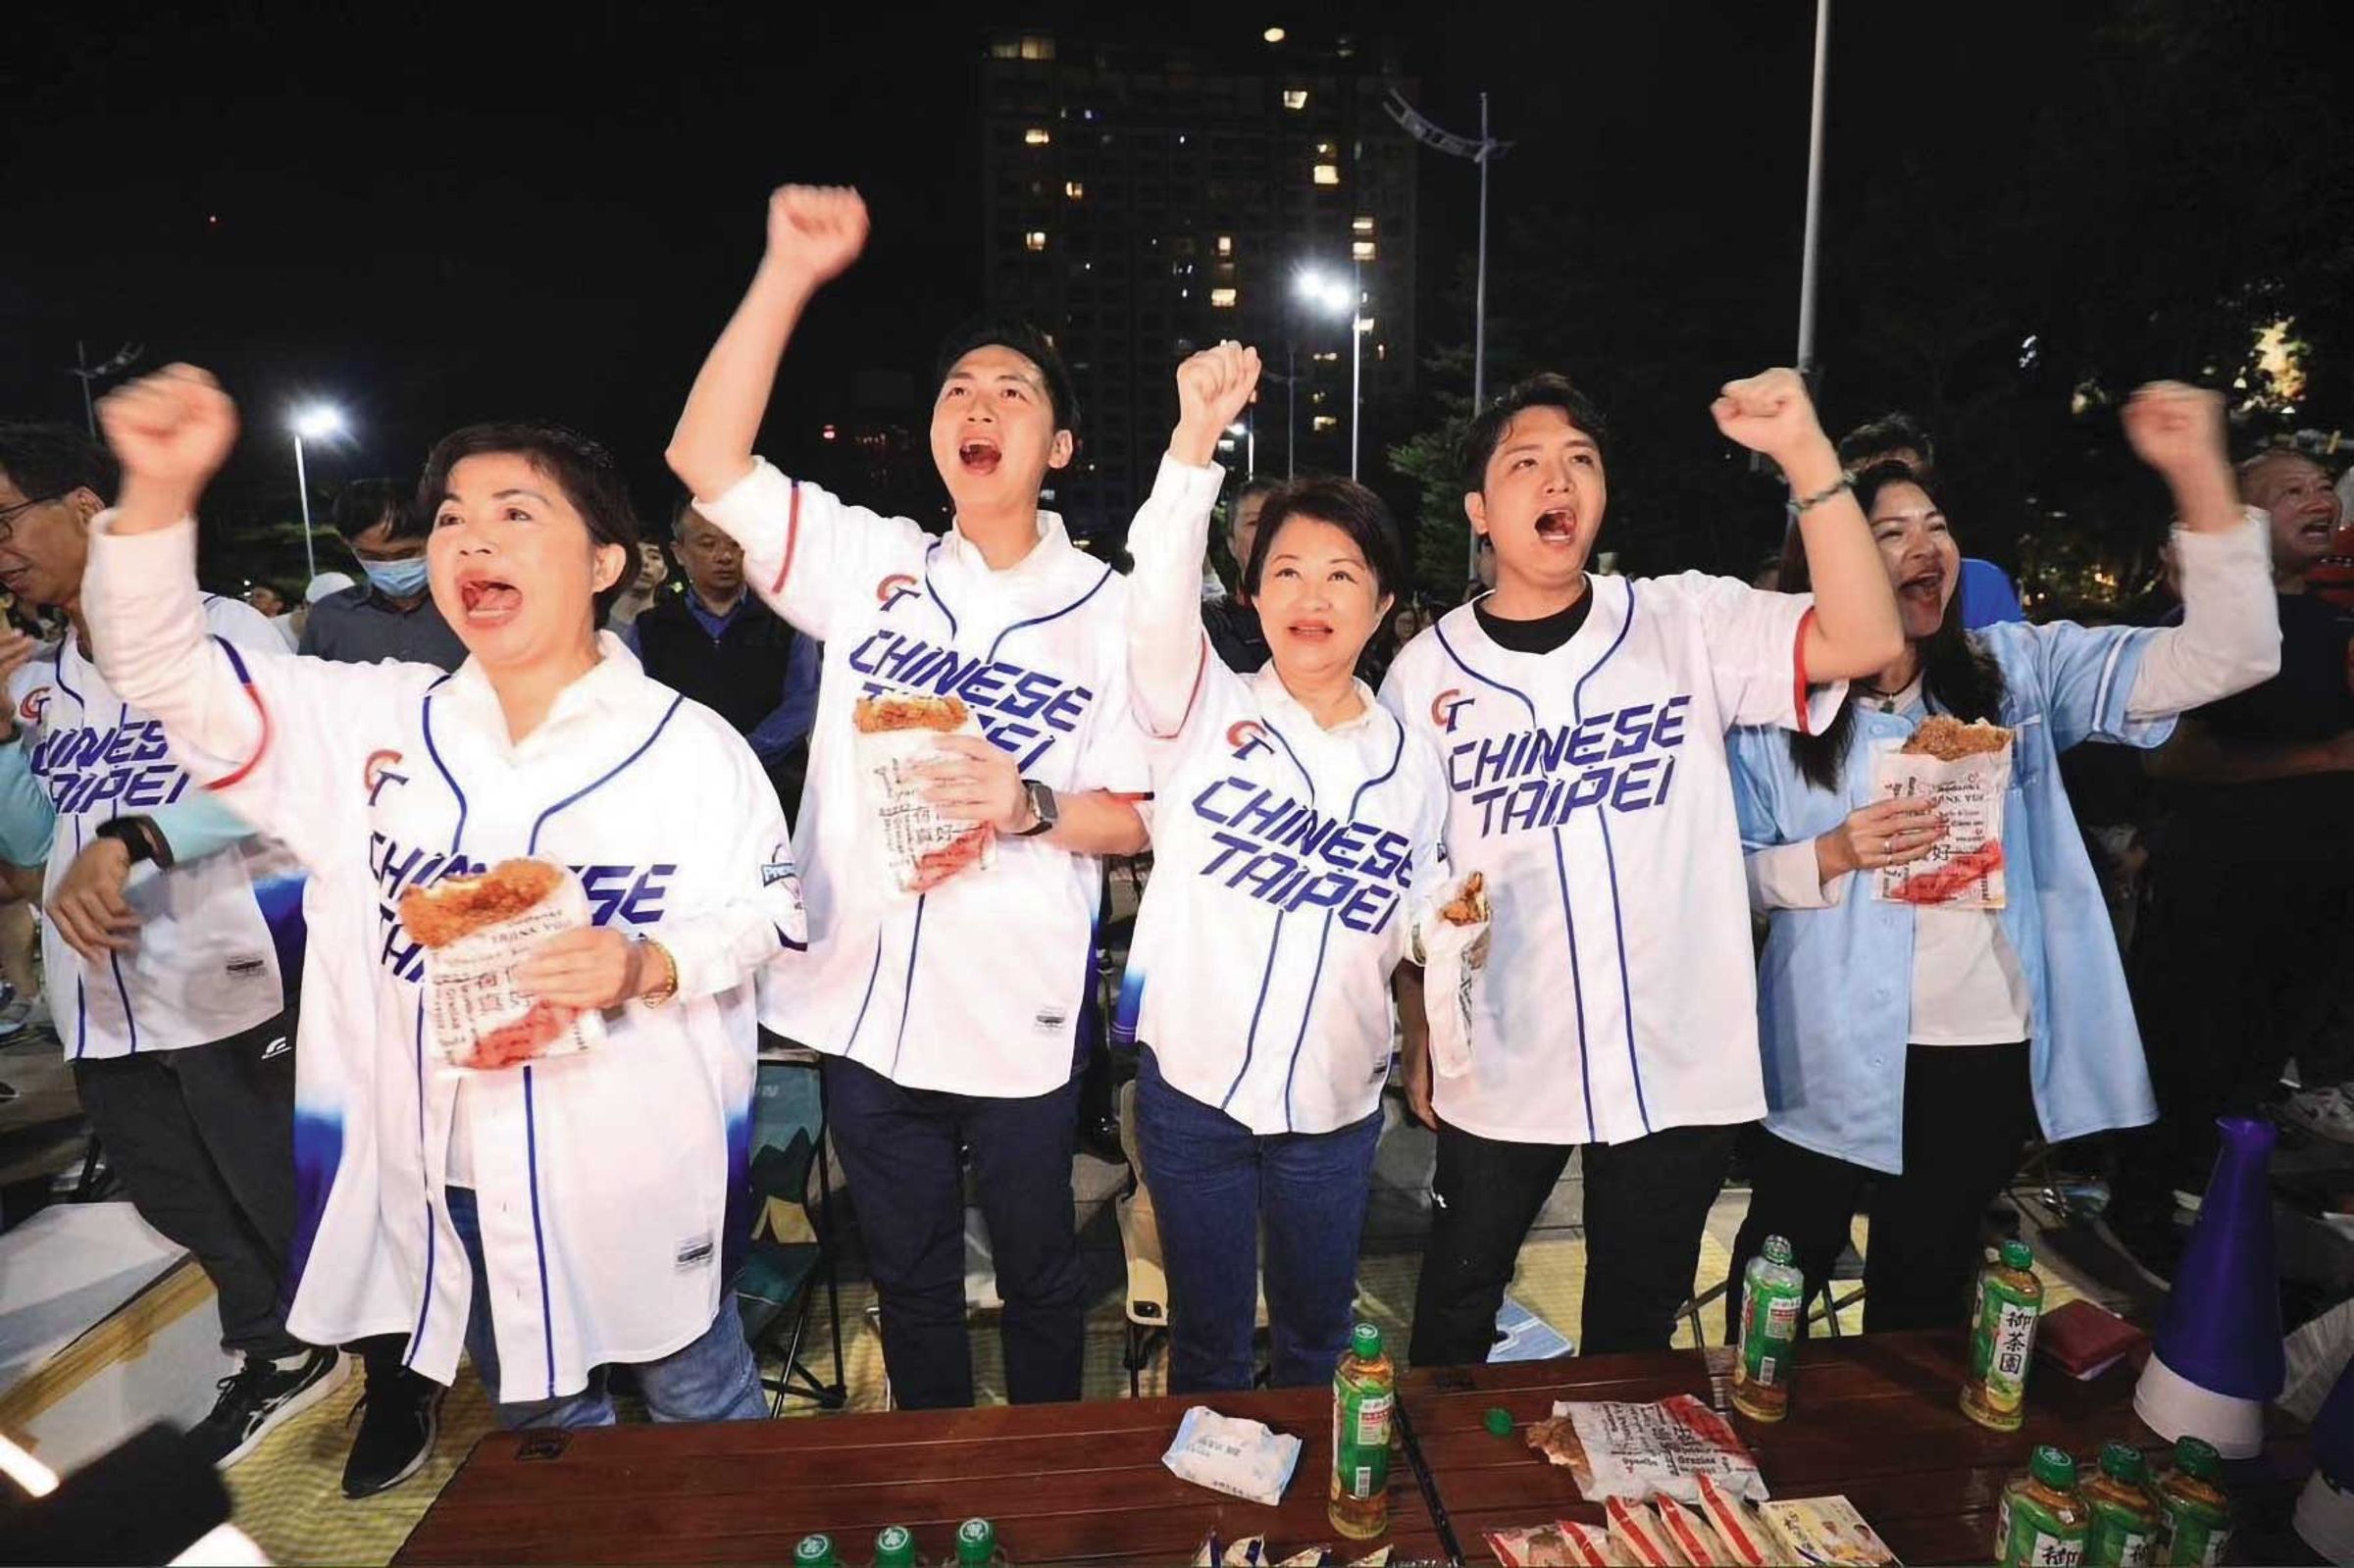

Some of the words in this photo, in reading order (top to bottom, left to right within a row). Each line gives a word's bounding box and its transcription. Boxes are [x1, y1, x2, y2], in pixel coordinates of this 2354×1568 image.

[848, 629, 1094, 733] CHINESE
[1448, 694, 1693, 793] CHINESE
[1472, 755, 1676, 838] TAIPEI
[1199, 831, 1401, 936] TAIPEI
[1996, 1311, 2031, 1374] 御茶園
